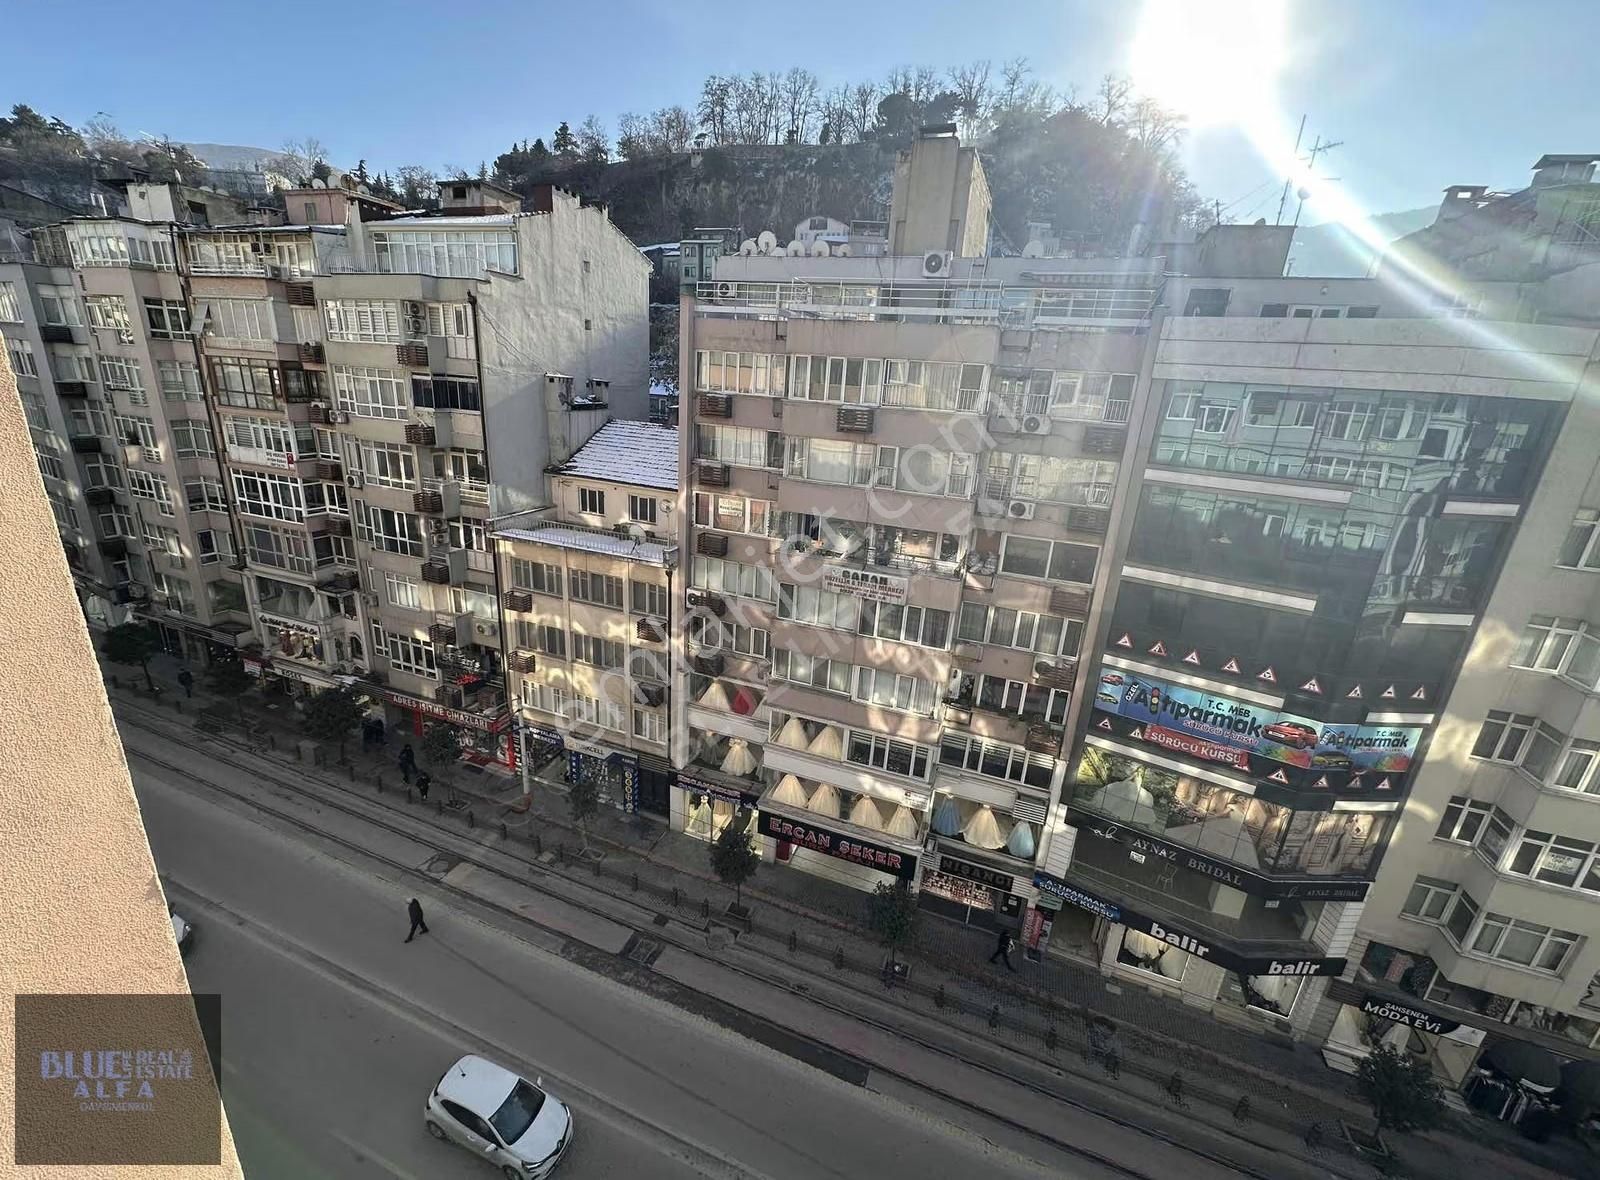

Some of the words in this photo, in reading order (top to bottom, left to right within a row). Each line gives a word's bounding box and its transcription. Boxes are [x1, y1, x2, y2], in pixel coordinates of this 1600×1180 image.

[1228, 705, 1251, 718] MEB
[769, 816, 831, 848] ERCAN
[1132, 838, 1177, 861] AYNAZ
[1187, 857, 1242, 886] BRIDAL
[1150, 922, 1210, 957] balir
[1268, 961, 1320, 975] balir
[1364, 1001, 1410, 1025] MODA
